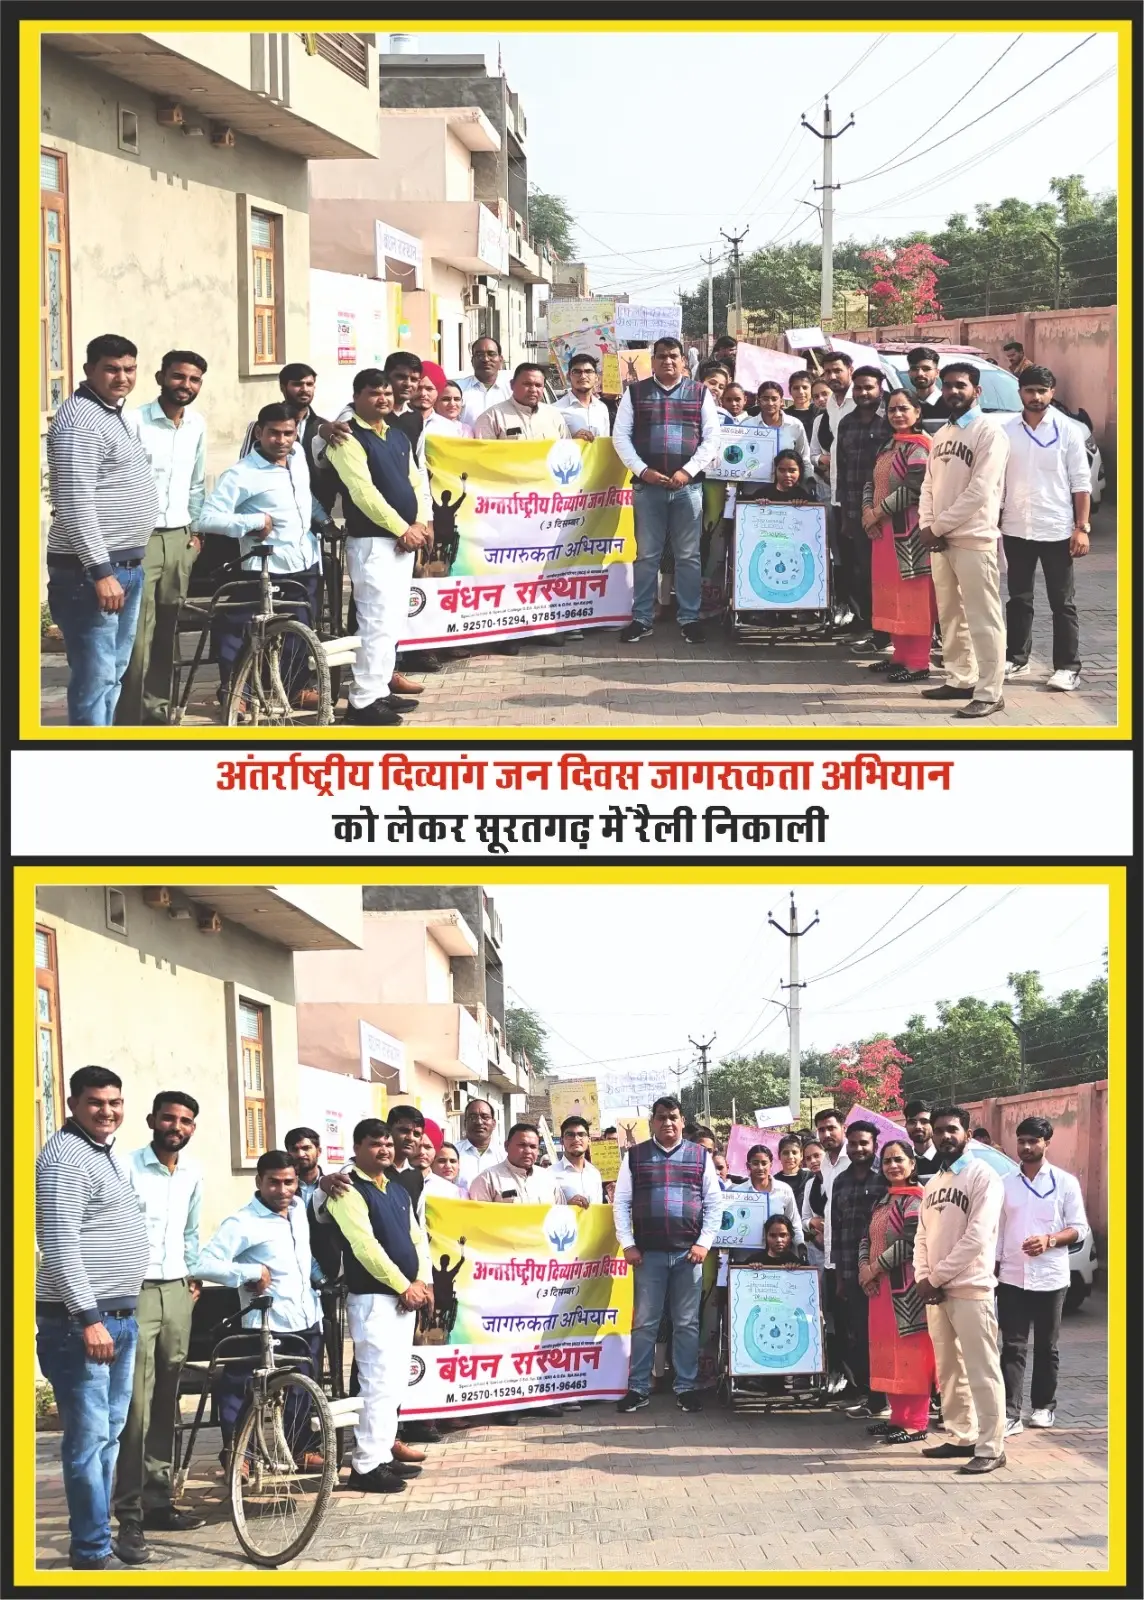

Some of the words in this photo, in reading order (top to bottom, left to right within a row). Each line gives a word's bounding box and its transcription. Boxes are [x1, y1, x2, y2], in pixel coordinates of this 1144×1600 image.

[550, 489, 588, 514] दिव्यांग
[588, 490, 605, 509] जन
[484, 543, 563, 565] जागरुकता
[564, 535, 626, 558] अभियान
[437, 580, 506, 614] बंधन
[514, 574, 609, 605] संस्थान
[446, 622, 460, 634] M.
[462, 614, 530, 632] 92570-15294,
[531, 607, 595, 623] 97851-96463
[926, 1187, 970, 1214] OLCANO
[547, 1257, 583, 1282] दिव्यांग
[583, 1260, 600, 1279] जन
[600, 1255, 629, 1277] दिवस
[482, 1313, 560, 1333] जागरुकता
[560, 1305, 619, 1328] अभियान
[436, 1349, 503, 1383] बंधन
[511, 1344, 603, 1375] संस्थान
[446, 1393, 458, 1404] M.
[461, 1385, 525, 1402] 92570-15294,
[527, 1380, 588, 1395] 97851-96463
